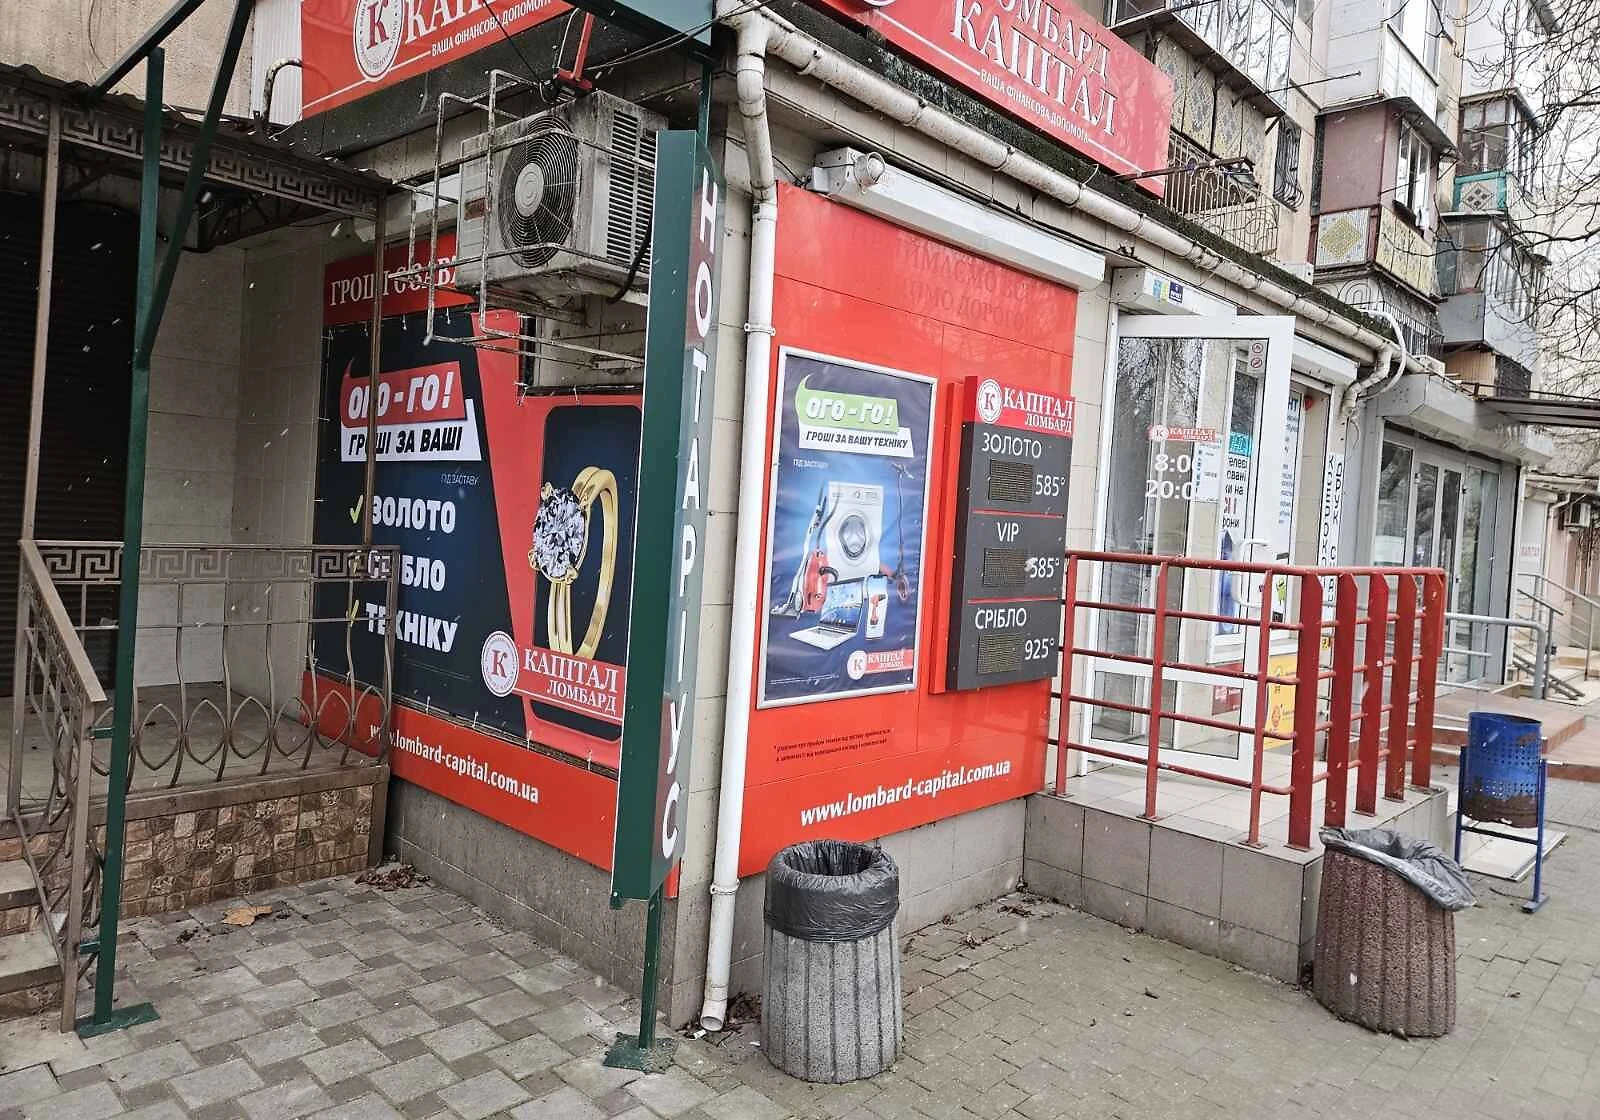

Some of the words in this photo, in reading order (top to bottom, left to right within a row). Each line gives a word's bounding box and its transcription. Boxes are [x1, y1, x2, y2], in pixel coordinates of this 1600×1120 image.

[431, 38, 454, 57] ВАША
[454, 15, 500, 45] ФІНАНСОВА
[980, 70, 1005, 95] ВАША
[1003, 387, 1074, 419] КАПІТАЛ
[806, 431, 835, 441] ГРОШІ
[836, 433, 847, 443] ЗА
[848, 435, 873, 446] ВАШУ
[874, 437, 908, 448] ТЕХНІКУ
[1025, 413, 1072, 433] ЛОМБАРД
[349, 431, 392, 455] ГРШІ
[396, 430, 415, 453] ЗА
[420, 426, 463, 452] ВАШІ
[981, 432, 1042, 459] ЗОЛОТО
[372, 496, 456, 534] ЗОЛОТО
[661, 167, 718, 859] НОТАРІУС
[997, 522, 1019, 542] VIP
[367, 550, 446, 592] СБЛО
[975, 607, 1027, 630] СРІБЛО
[524, 648, 619, 693] КАПІТАЛ
[547, 679, 617, 716] ЛОМБАРД
[370, 724, 540, 804] ww.lombard-capital.com.ua
[800, 760, 1011, 826] www.lombard-capital.com.ua
